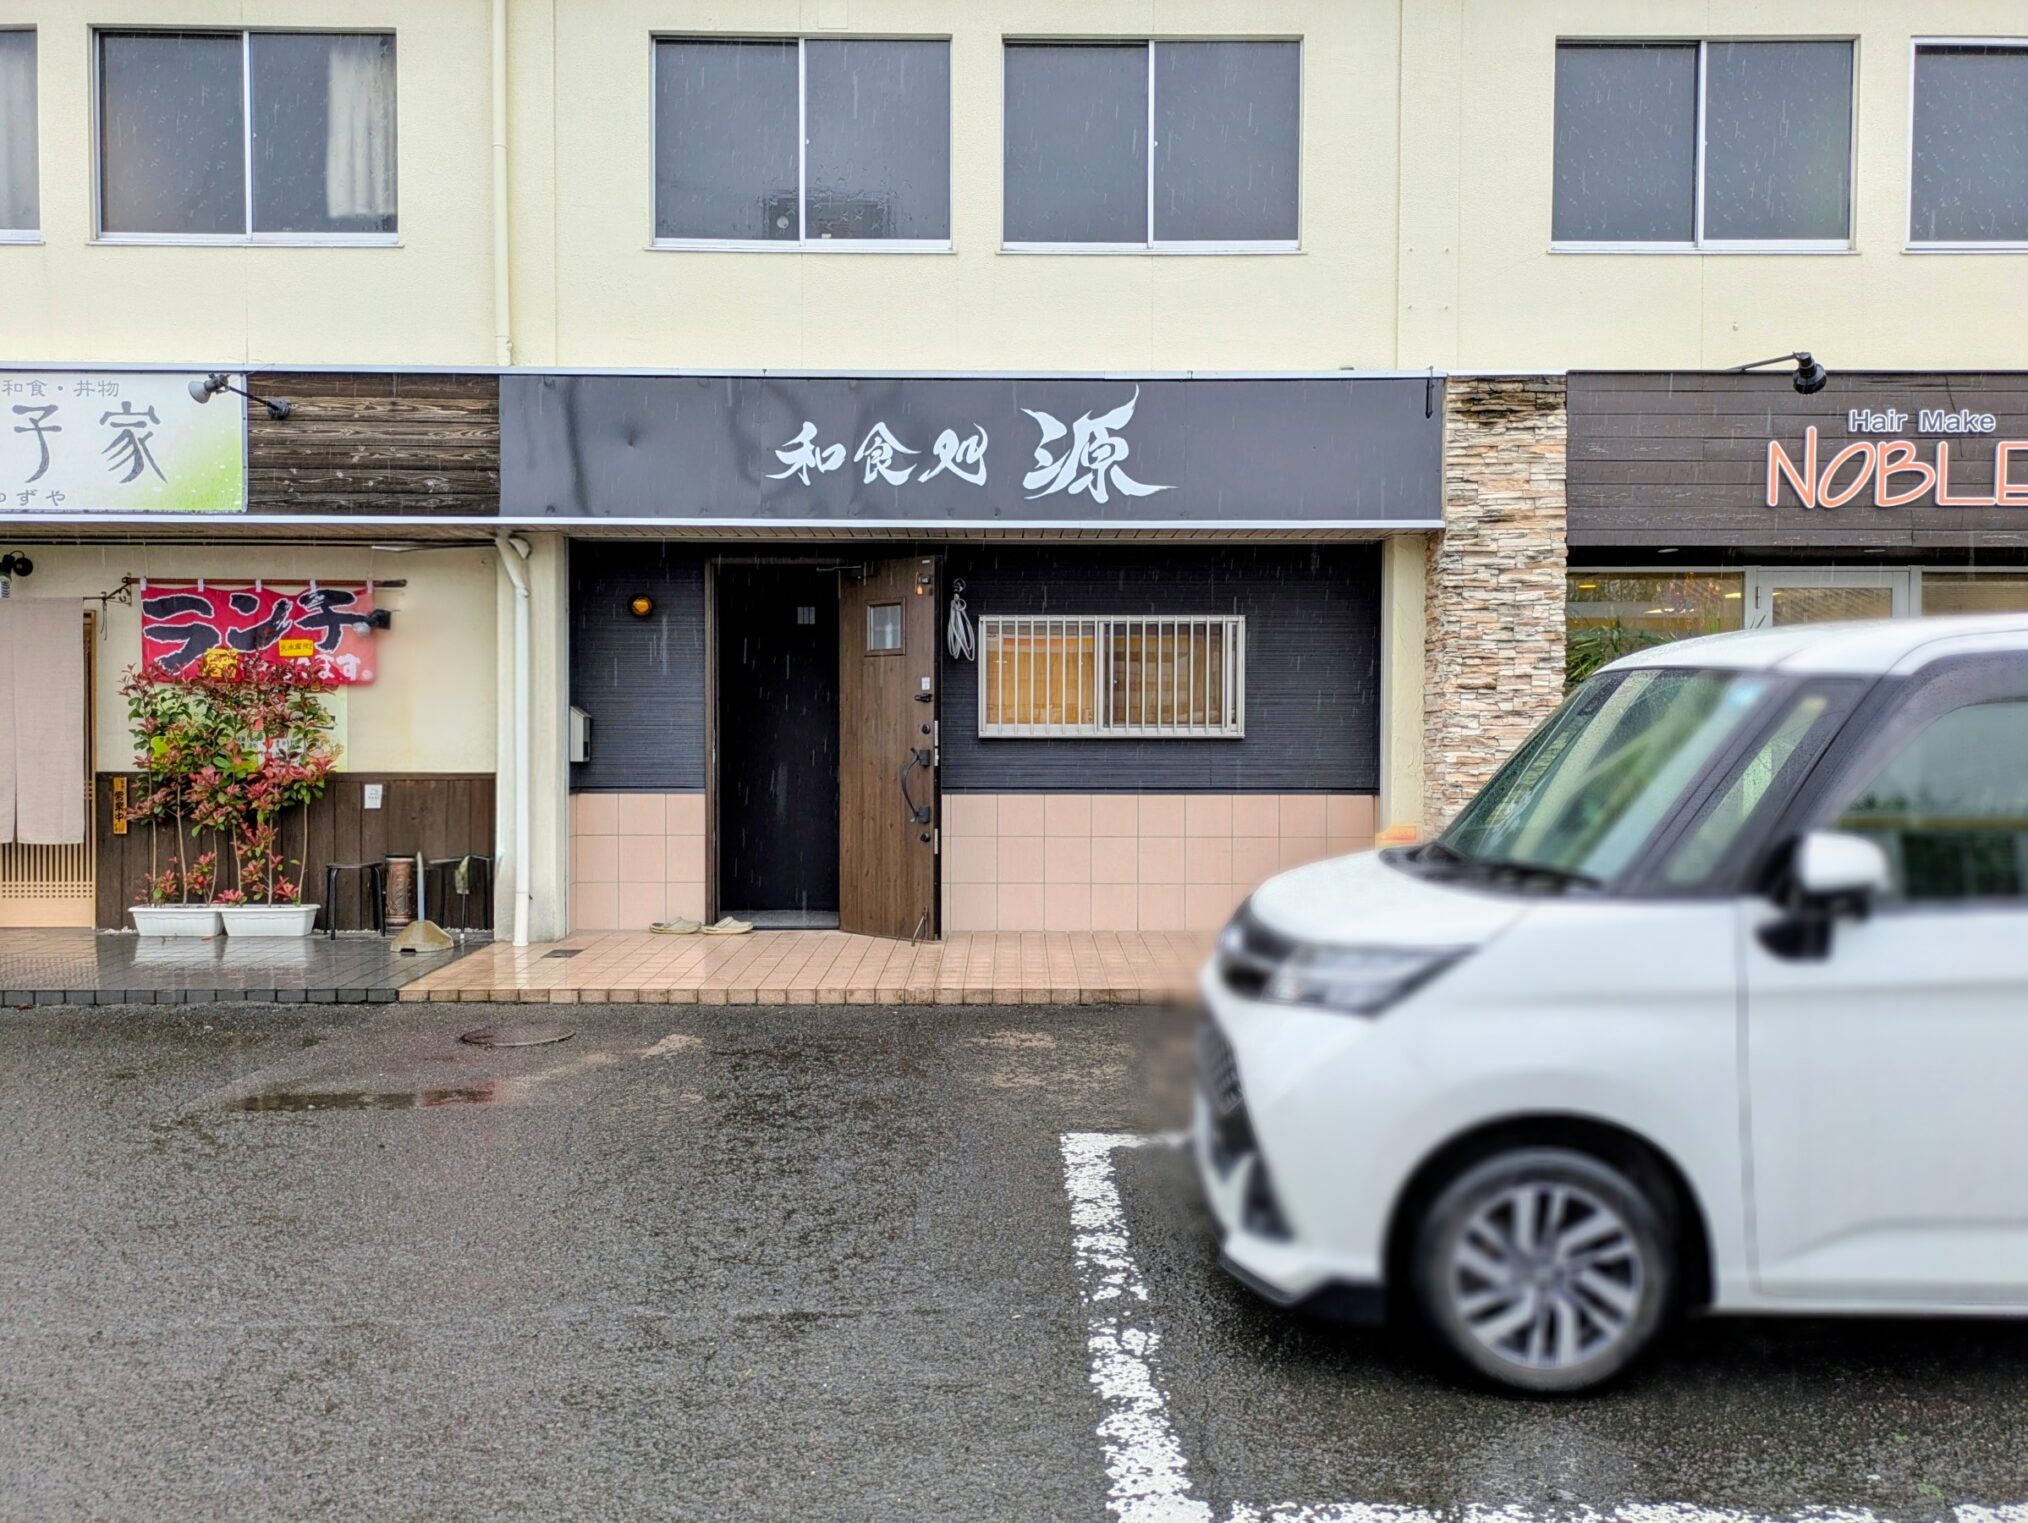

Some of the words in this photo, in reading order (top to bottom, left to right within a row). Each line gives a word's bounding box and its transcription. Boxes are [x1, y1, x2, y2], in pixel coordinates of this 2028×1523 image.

[764, 420, 989, 487] 和食処
[1019, 383, 1180, 504] 源
[1849, 408, 1908, 433] Hair
[1918, 408, 1997, 433] Make
[141, 588, 370, 677] ランチ
